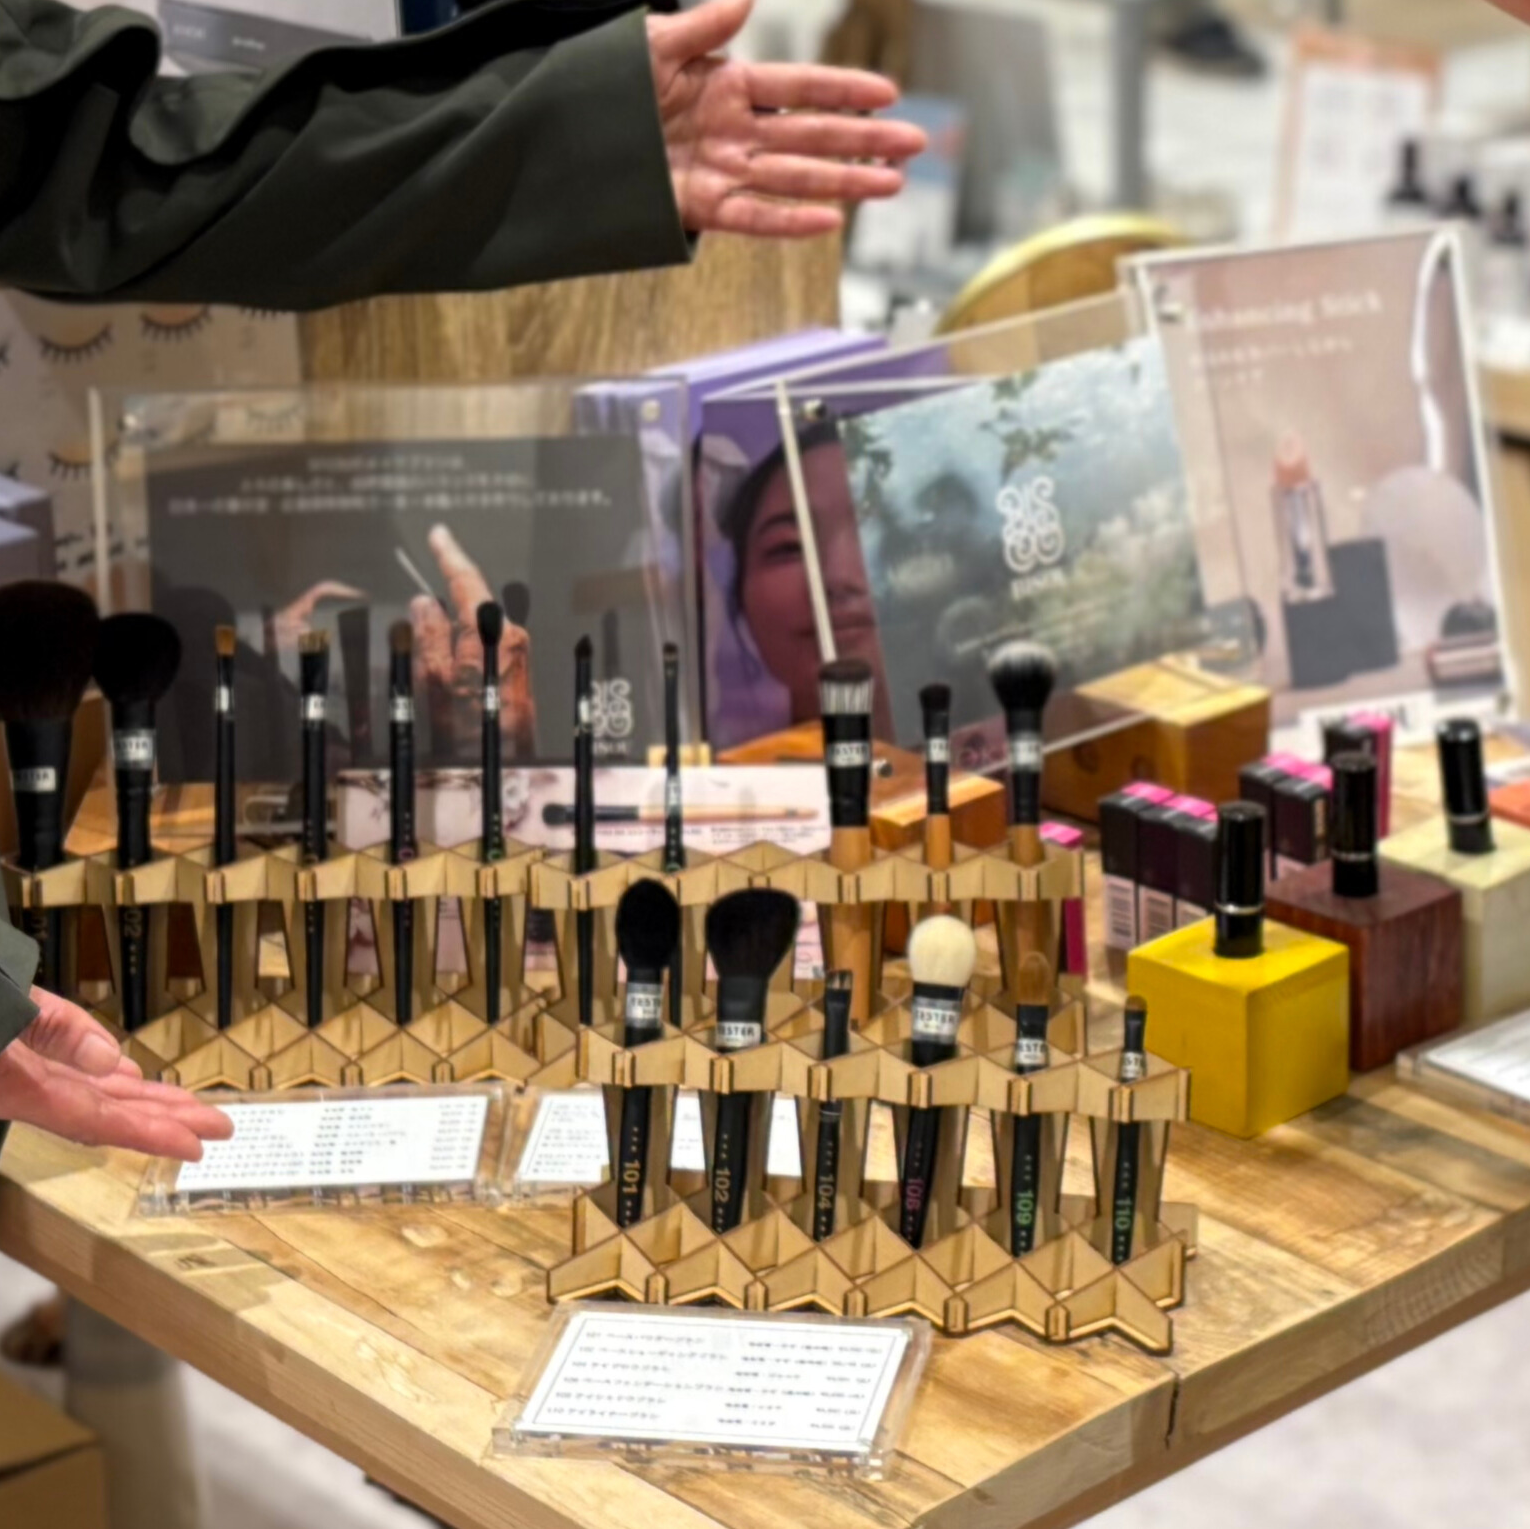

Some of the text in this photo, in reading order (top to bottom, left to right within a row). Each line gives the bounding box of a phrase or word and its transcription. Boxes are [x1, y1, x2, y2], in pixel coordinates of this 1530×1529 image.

[622, 1159, 640, 1194] 101
[714, 1168, 732, 1204] 102
[817, 1173, 834, 1209] 104
[1015, 1189, 1033, 1225] 109
[1114, 1197, 1133, 1230] 110
